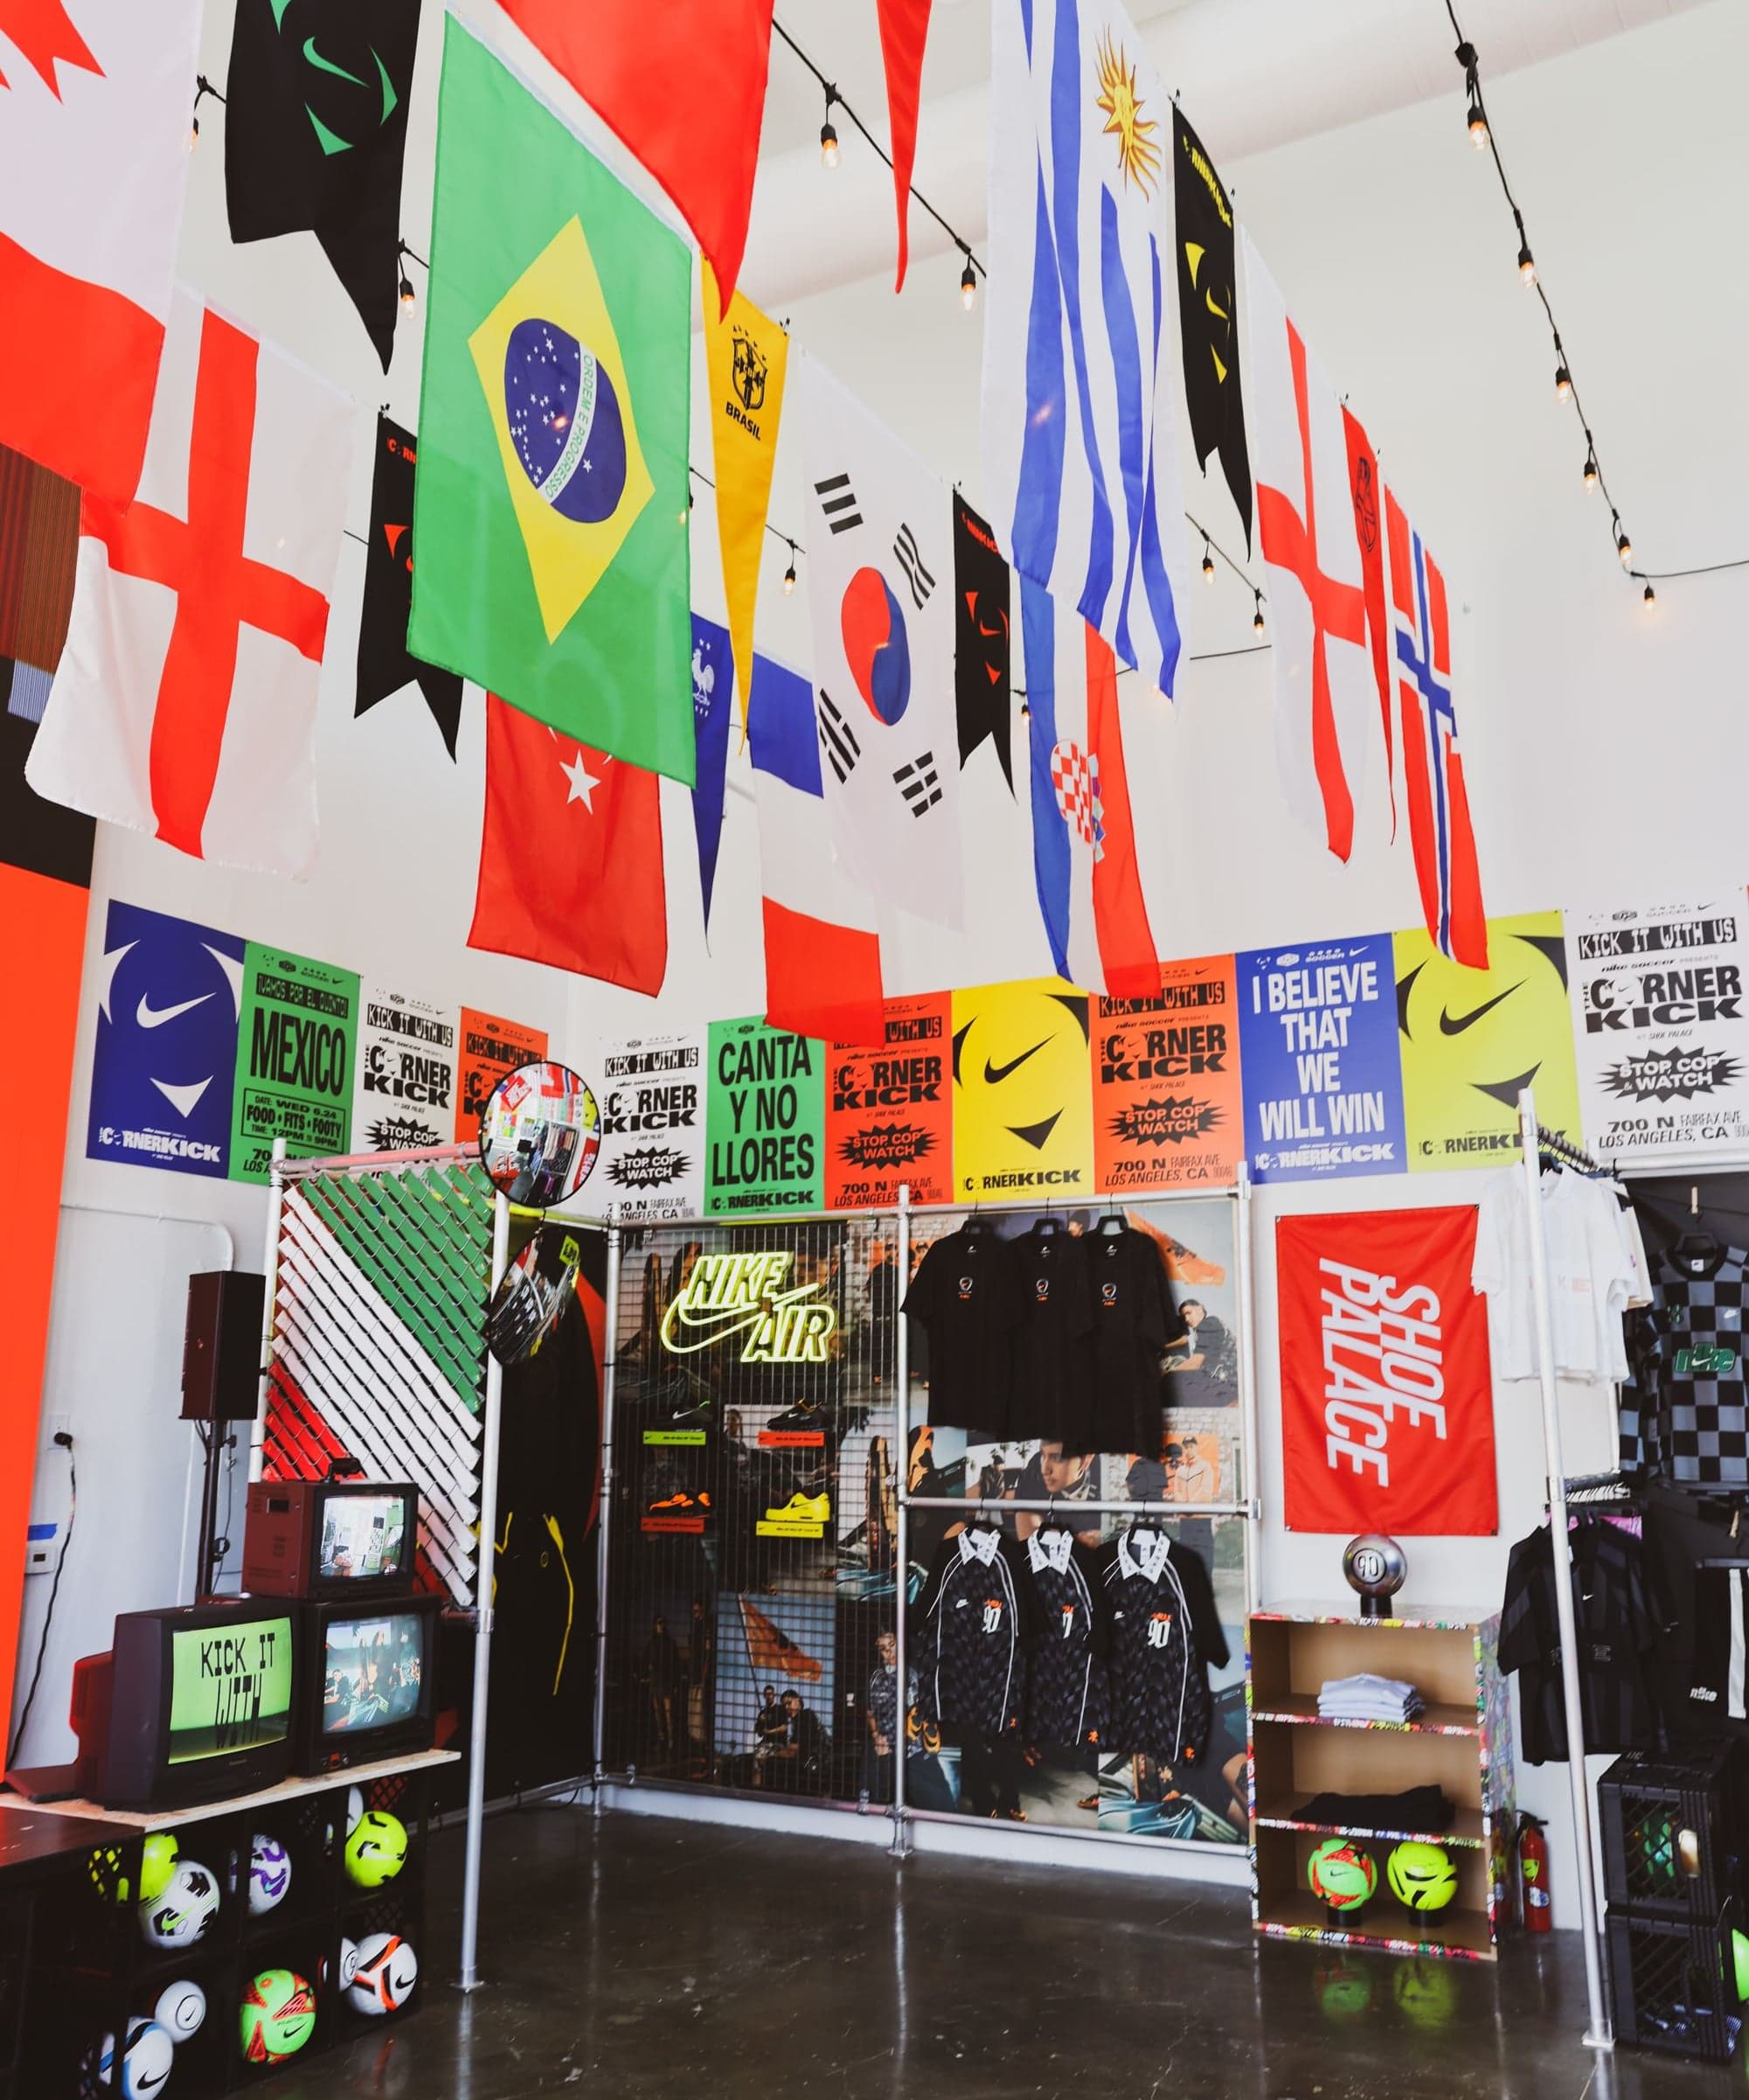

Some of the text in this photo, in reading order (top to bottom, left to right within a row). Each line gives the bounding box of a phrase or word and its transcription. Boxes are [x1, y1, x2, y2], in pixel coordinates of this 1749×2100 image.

[545, 354, 593, 498] ORDEM E PROGRESSO
[725, 400, 761, 442] BRASIL
[1580, 918, 1734, 958] KICK IT WITH US
[290, 984, 303, 1003] POR
[307, 989, 316, 1007] EL
[1100, 995, 1134, 1017] KICK
[1163, 984, 1198, 1008] WITH
[1205, 982, 1224, 1004] US
[1253, 961, 1379, 1014] I BELIEVE
[368, 1004, 453, 1047] KICK IT WITH US
[889, 1017, 940, 1040] WITH US
[1586, 997, 1744, 1033] KICK
[1280, 1006, 1352, 1053] THAT
[250, 1006, 346, 1097] MEXICO
[467, 1033, 489, 1058] KICK
[606, 1048, 698, 1077] KICK IT WITH US
[718, 1033, 812, 1087] CANTA
[1101, 1053, 1227, 1084] KICK
[1296, 1052, 1341, 1095] WE
[1676, 1055, 1721, 1073] COP
[363, 1071, 450, 1110] KICK
[1623, 1072, 1713, 1091] & WATCH
[254, 1095, 337, 1120] DATE: WED 6.24
[729, 1084, 797, 1134] Y NO
[833, 1083, 940, 1112] KICK
[246, 1104, 342, 1138] FOOD FITS FOOTY
[603, 1109, 696, 1135] KICK
[1170, 1105, 1204, 1120] COP
[1259, 1091, 1385, 1143] WILL WIN
[1607, 1109, 1742, 1135] 700 N FAIRFAX AVE
[272, 1128, 304, 1142] 12PM
[315, 1135, 338, 1148] 9PM
[413, 1130, 435, 1145] COP
[892, 1132, 920, 1145] COP
[1137, 1118, 1199, 1136] WATCH
[1599, 1134, 1624, 1149] LOS
[1628, 1128, 1697, 1147] ANGELES,
[1701, 1126, 1729, 1140] CA
[243, 1159, 263, 1172] LOS
[252, 1148, 273, 1162] 70
[652, 1155, 678, 1166] COP
[712, 1133, 815, 1187] LLORES
[863, 1145, 915, 1159] WATCH
[1113, 1153, 1221, 1173] 700 N FAIRFAX AVE
[626, 1166, 673, 1180] WATCH
[1105, 1173, 1127, 1187] LOS
[1128, 1169, 1183, 1186] ANGELES,
[1186, 1167, 1209, 1180] CA
[834, 1195, 853, 1207] LOS
[841, 1181, 871, 1195] 700
[875, 1180, 887, 1192] N
[636, 1200, 648, 1211] N
[662, 1208, 678, 1220] CA
[685, 1251, 792, 1310] NIKE
[740, 1304, 836, 1364] AIR
[1378, 1275, 1447, 1441] SHOE
[1319, 1257, 1390, 1489] PALACE
[1357, 1555, 1379, 1577] 90
[982, 1605, 1003, 1634] 90
[1147, 1618, 1171, 1649] 90
[201, 1632, 275, 1679] KICK IT
[1689, 1686, 1718, 1703] nike
[215, 1672, 262, 1749] WITH
